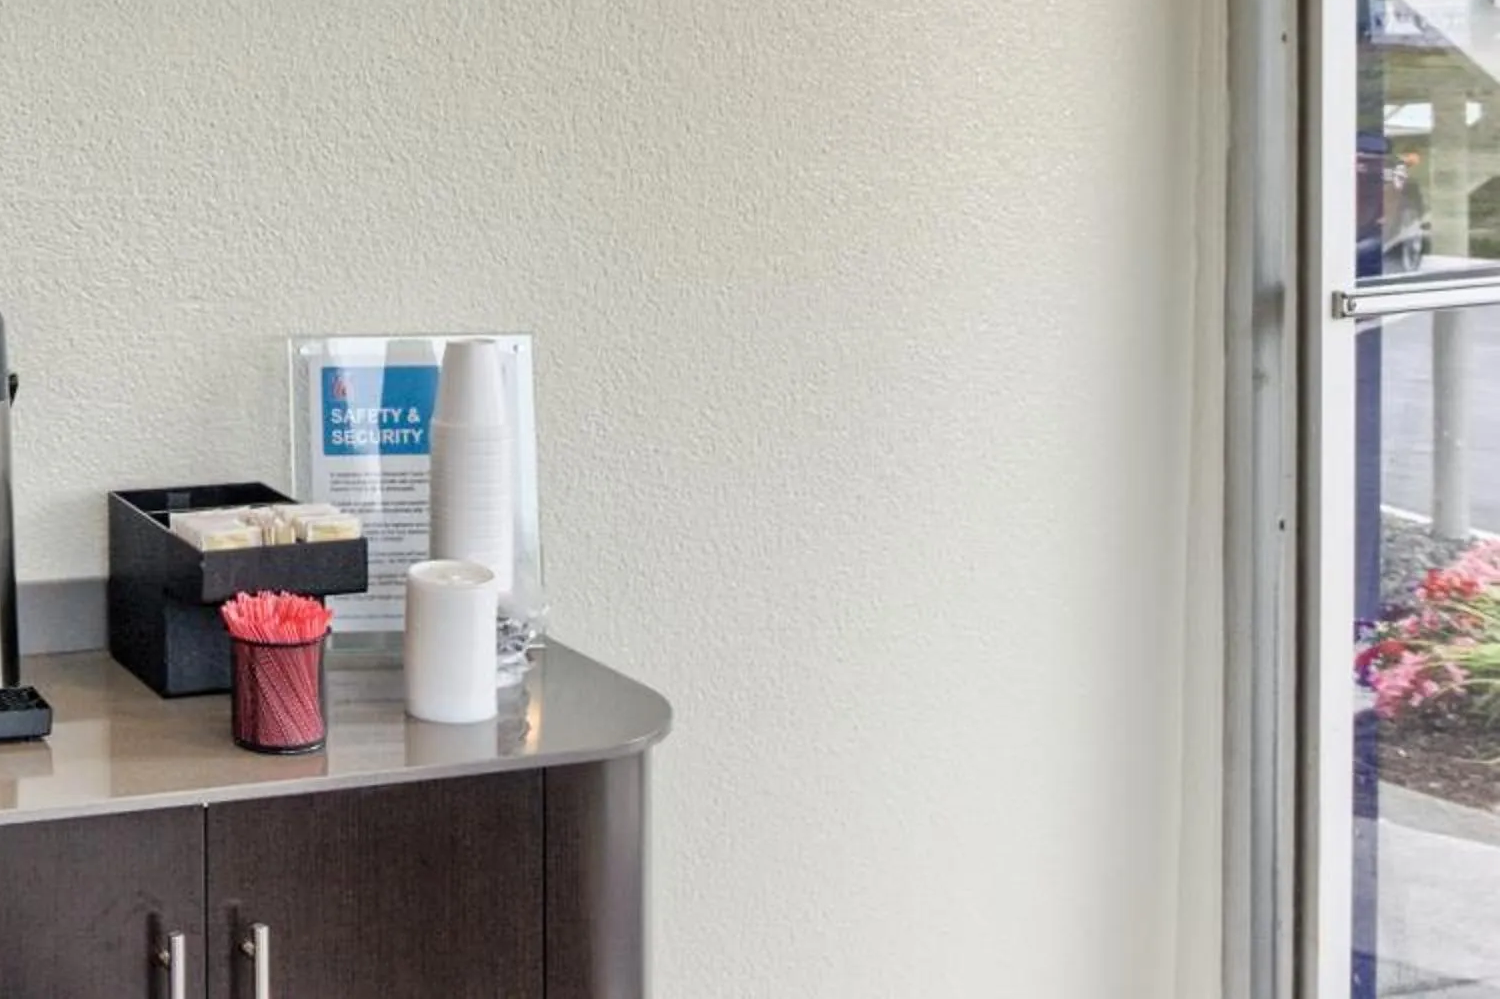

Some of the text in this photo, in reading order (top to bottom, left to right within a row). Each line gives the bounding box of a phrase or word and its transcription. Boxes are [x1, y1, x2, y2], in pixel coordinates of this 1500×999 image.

[331, 407, 421, 424] SAFETY &
[332, 429, 423, 446] SECURITY
